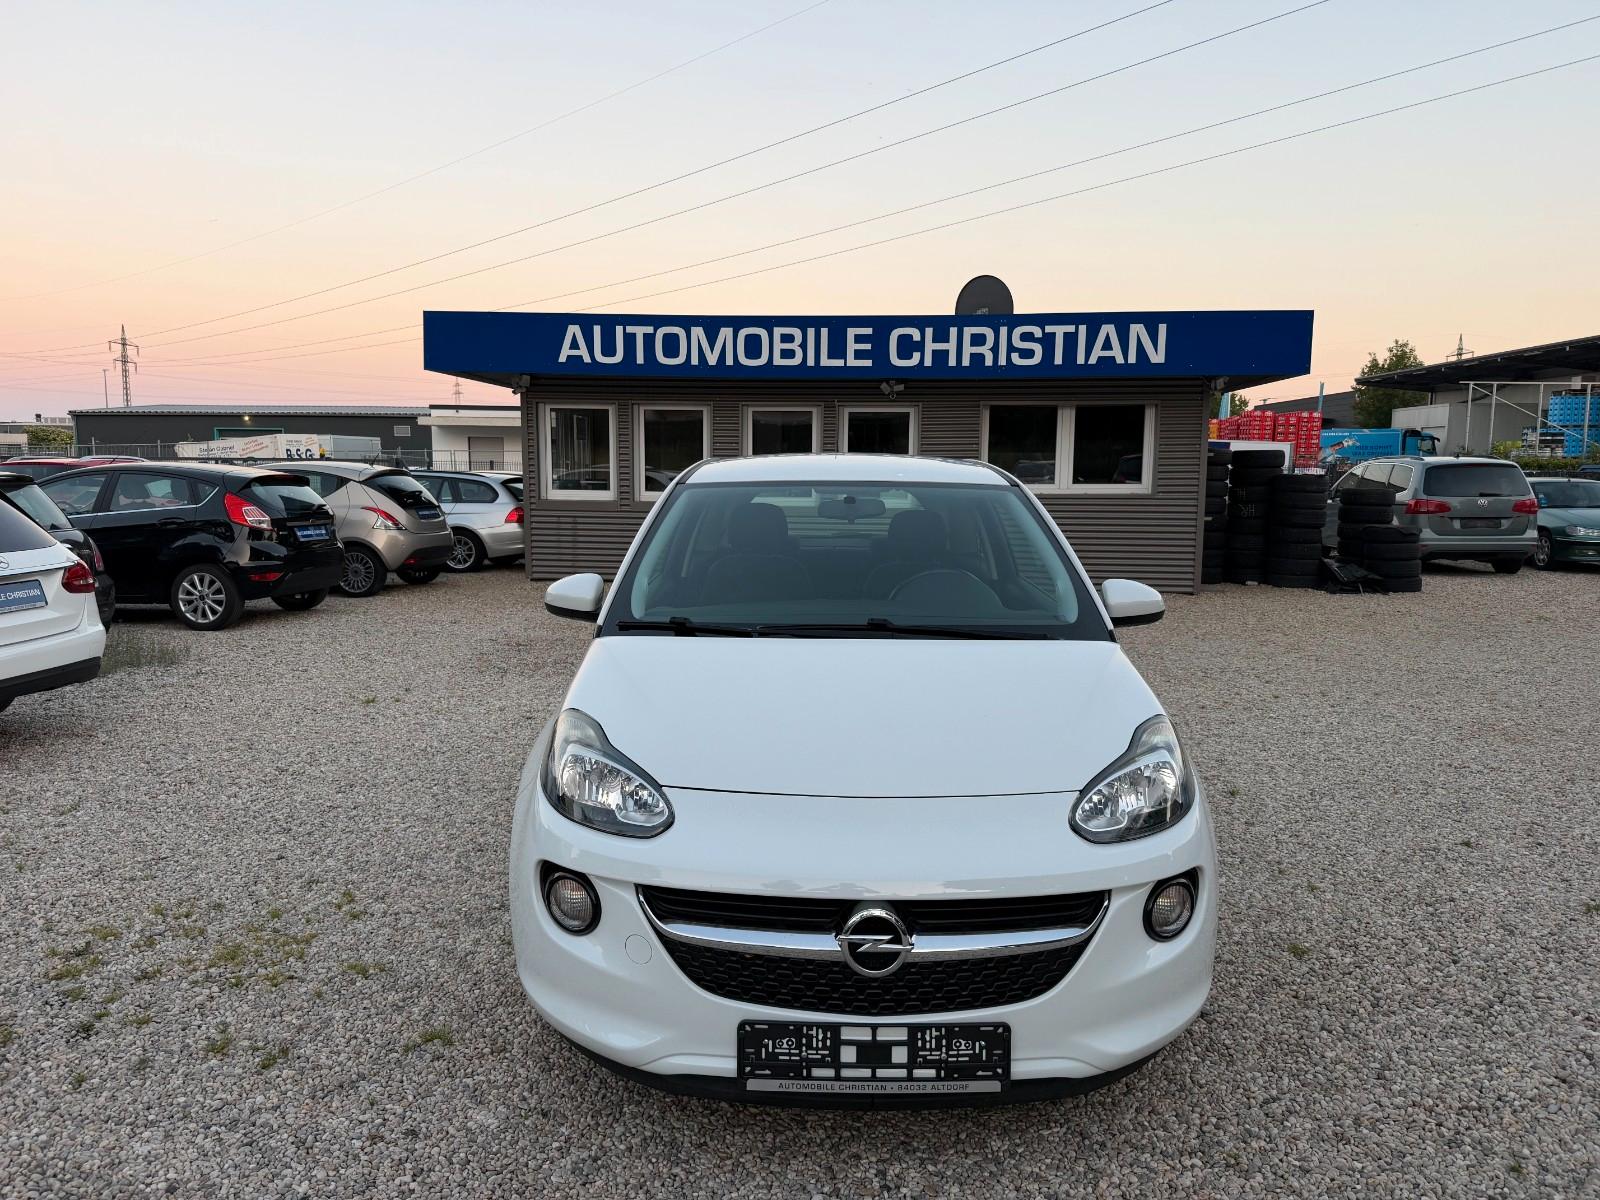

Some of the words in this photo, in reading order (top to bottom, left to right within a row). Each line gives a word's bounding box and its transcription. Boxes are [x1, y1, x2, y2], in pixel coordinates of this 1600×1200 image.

[558, 325, 873, 367] AUTOMOBILE
[889, 323, 1167, 367] CHRISTIAN
[7, 588, 40, 599] CHRISTIAN
[778, 1082, 836, 1092] AUTOMOBILE
[838, 1083, 887, 1092] CHRISTIAN
[897, 1084, 927, 1092] 84032
[930, 1083, 970, 1092] ALTDORF
